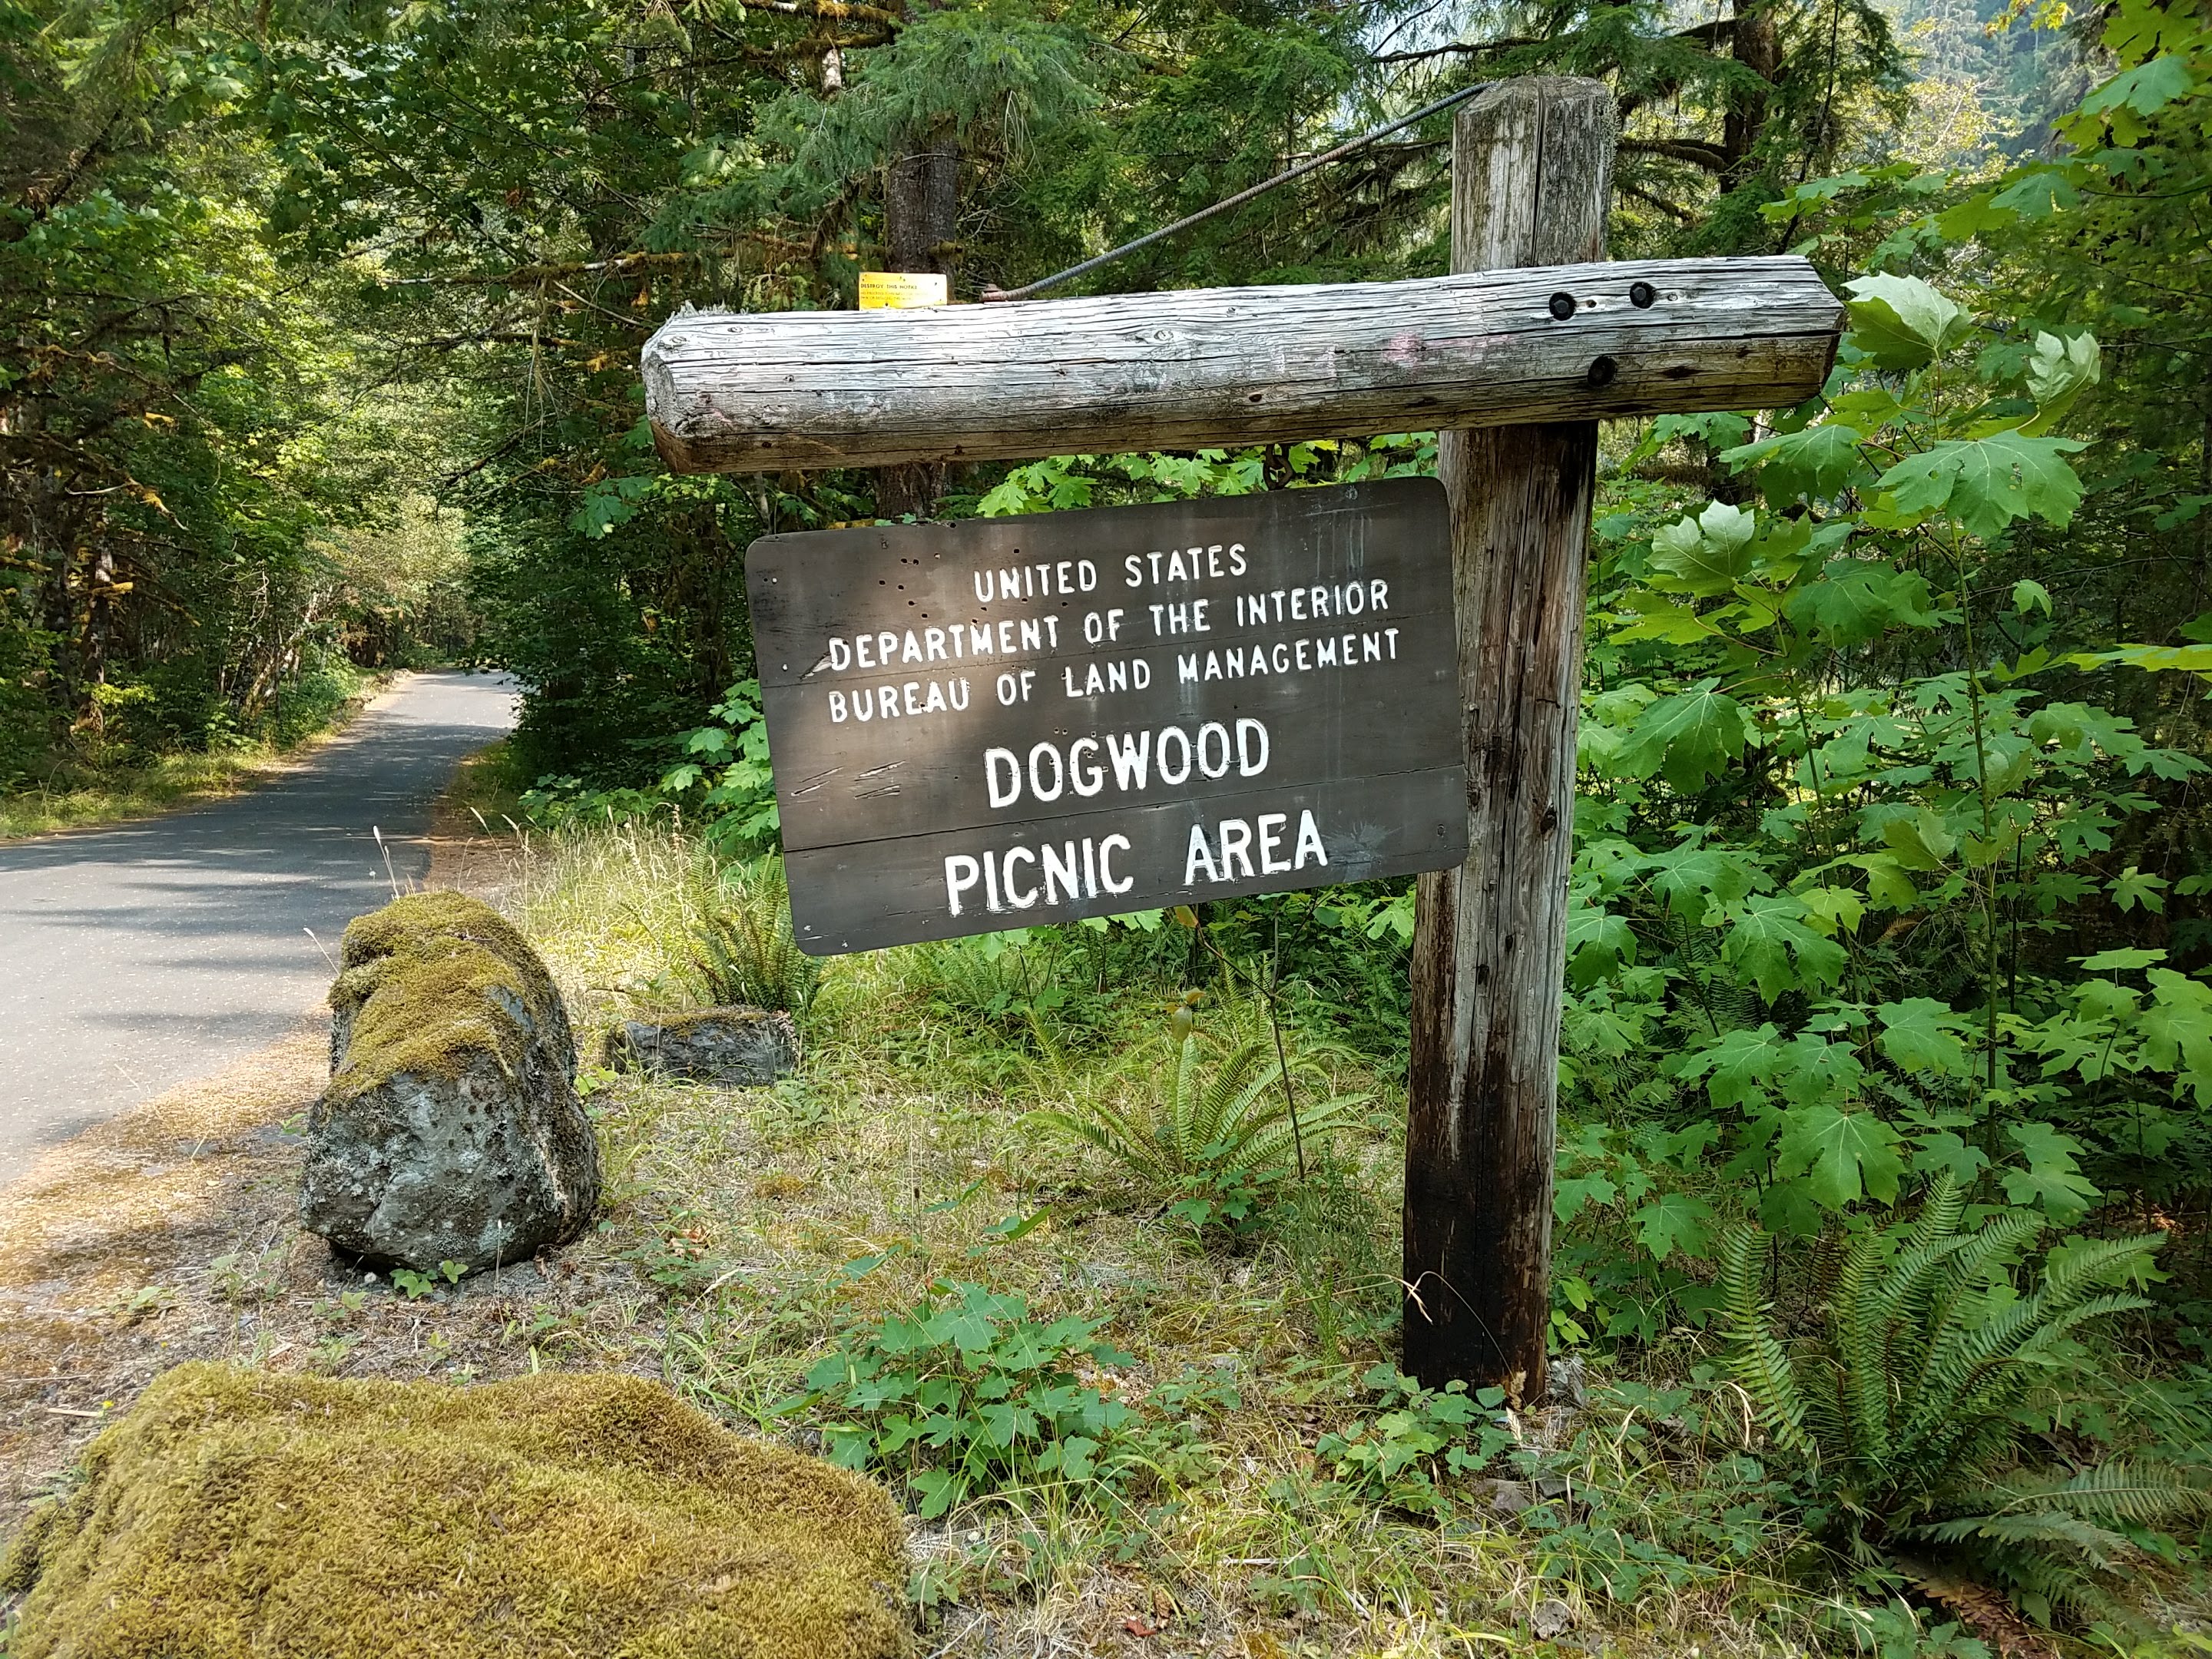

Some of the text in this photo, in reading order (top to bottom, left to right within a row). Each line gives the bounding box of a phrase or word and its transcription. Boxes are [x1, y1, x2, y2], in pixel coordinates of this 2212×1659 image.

[974, 543, 1247, 603] UNITED STATES
[830, 579, 1389, 671] DEPARTMENT OF THE INTERIOR
[830, 628, 1399, 722] BUREAU OF LAND MANAGEMENT
[985, 718, 1270, 808] DOGWOOD
[945, 810, 1328, 916] PICNIC AREA
